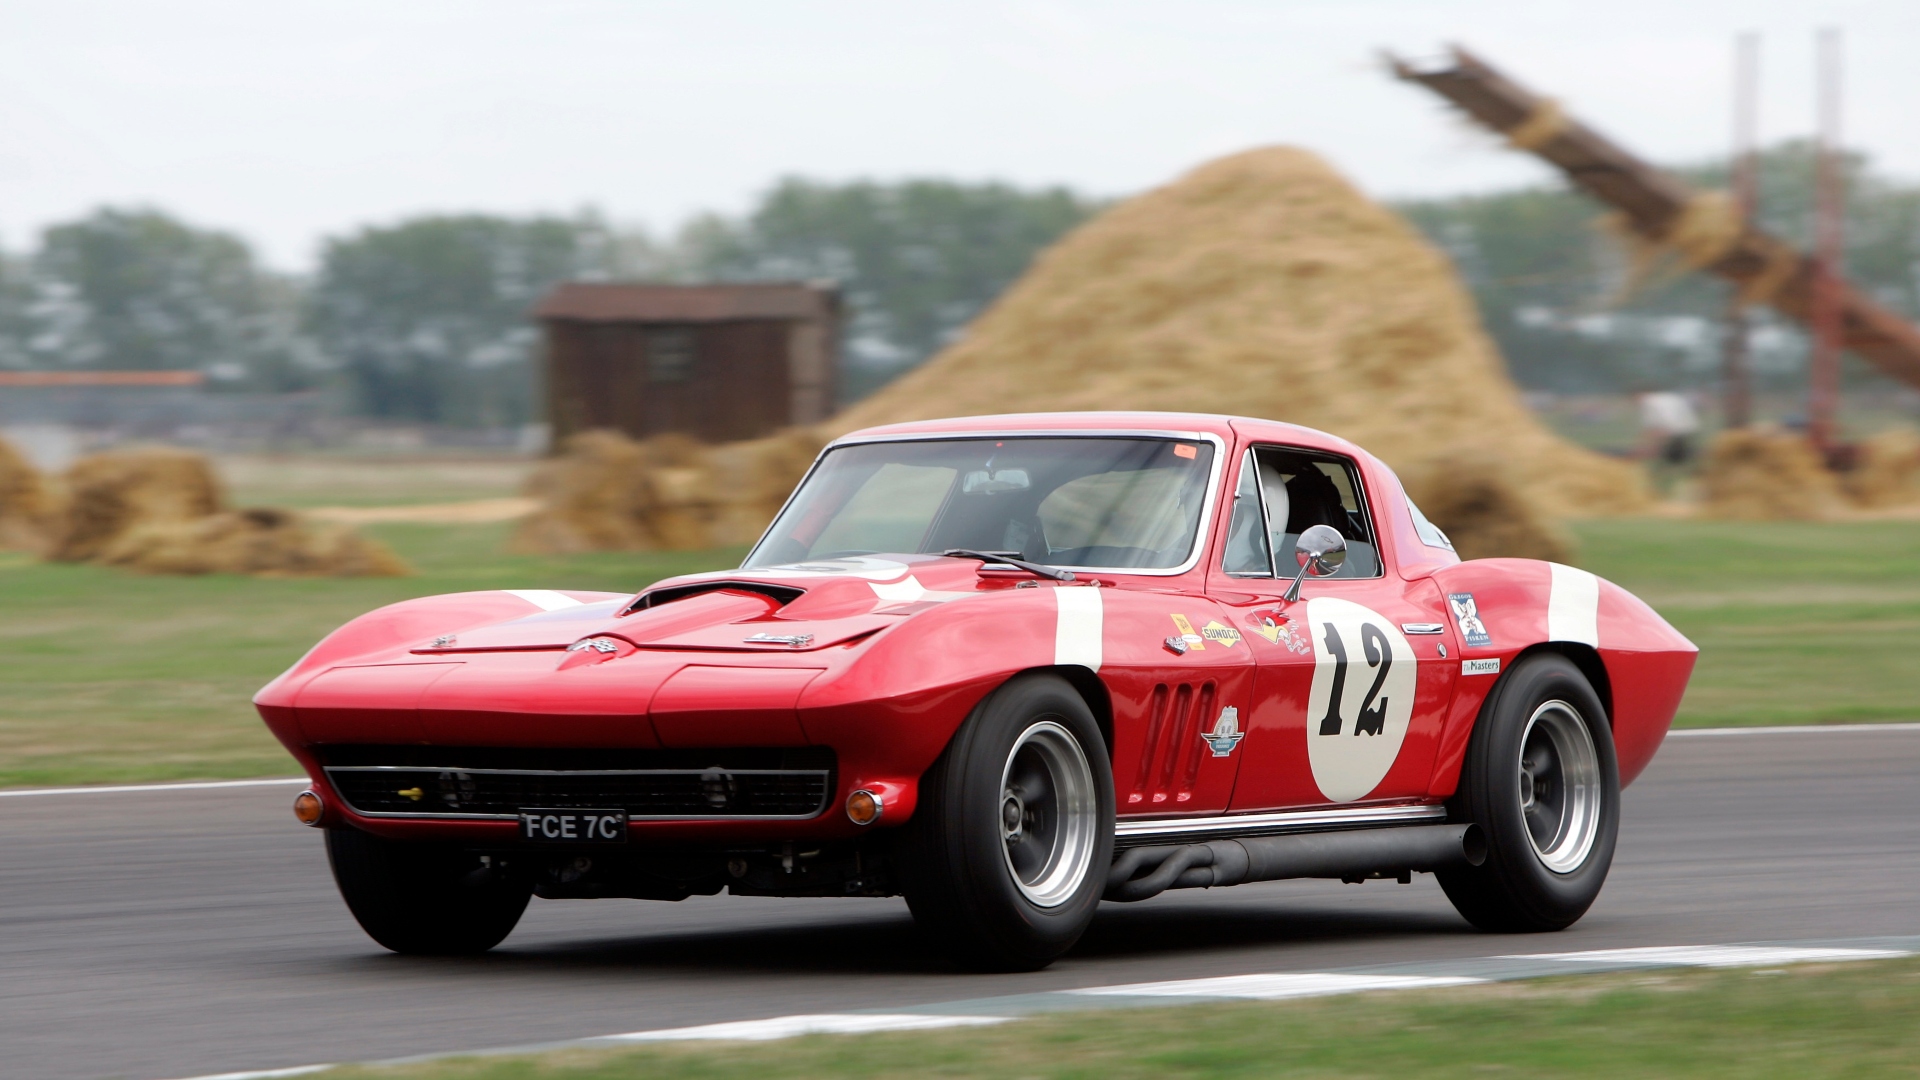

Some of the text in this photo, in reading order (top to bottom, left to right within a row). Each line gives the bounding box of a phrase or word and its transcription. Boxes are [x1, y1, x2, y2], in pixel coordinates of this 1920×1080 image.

[1203, 628, 1239, 640] SUNOCO
[1470, 660, 1499, 671] Masters
[1319, 622, 1393, 737] 12
[525, 814, 618, 839] FCE 7C
